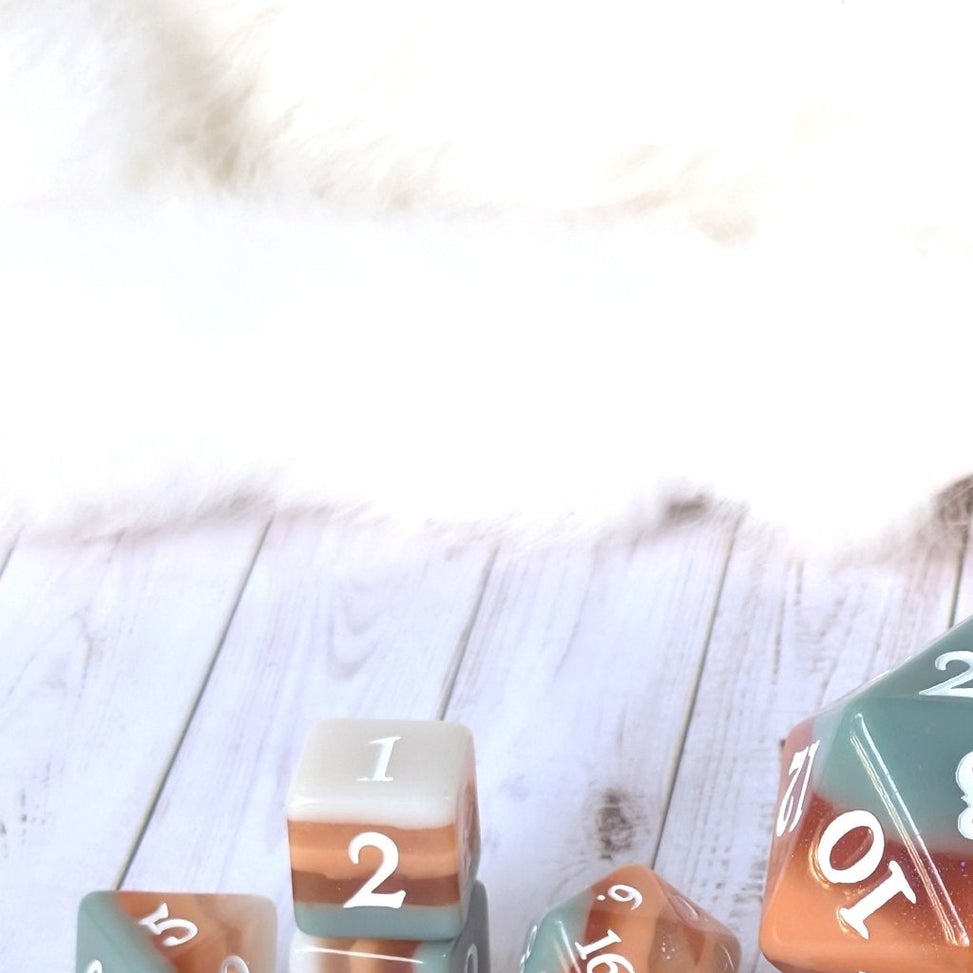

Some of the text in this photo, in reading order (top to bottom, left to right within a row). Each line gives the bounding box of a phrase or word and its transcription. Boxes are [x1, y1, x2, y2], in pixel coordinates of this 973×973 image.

[357, 736, 402, 782] 1
[343, 832, 407, 909] 2
[816, 809, 917, 940] 10
[139, 903, 198, 947] 5
